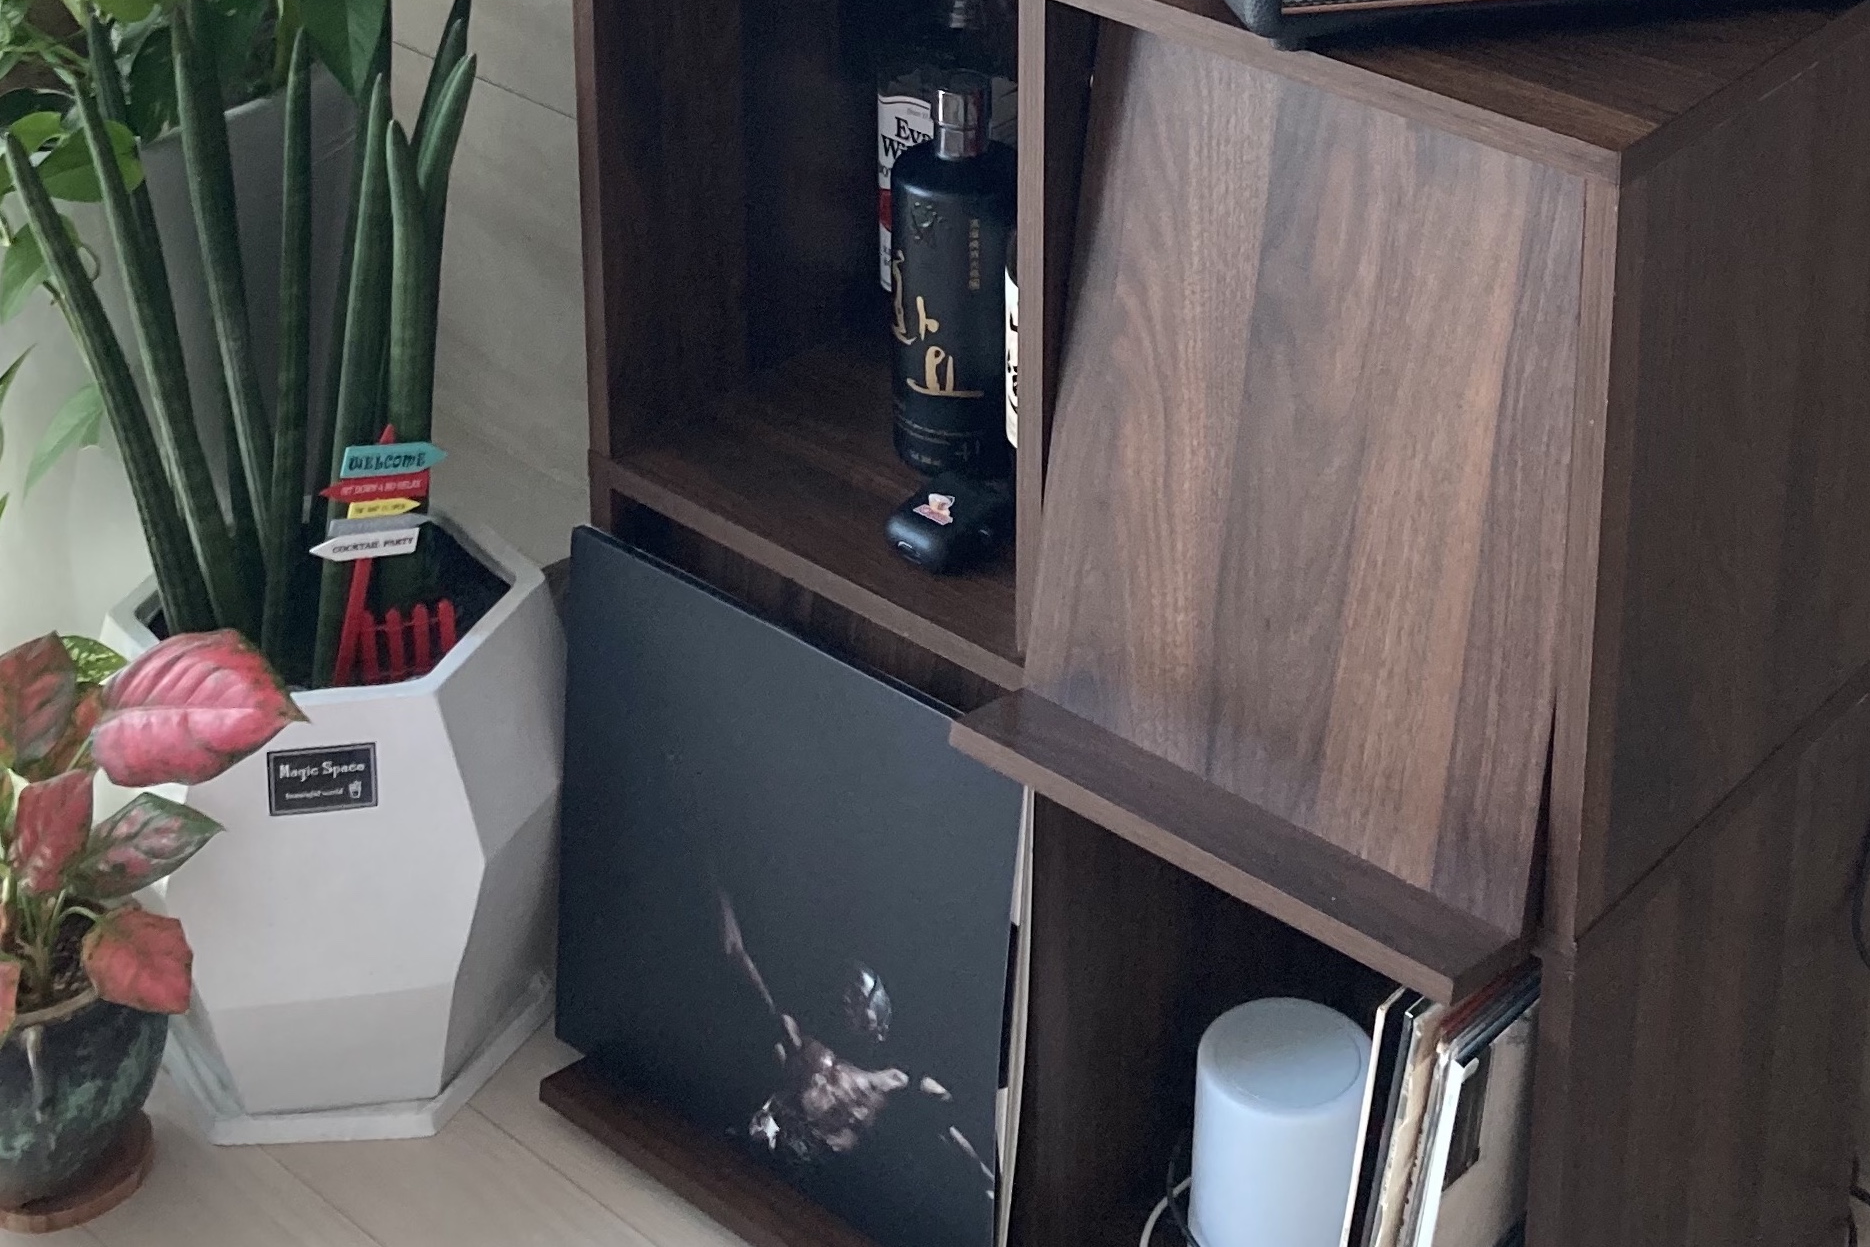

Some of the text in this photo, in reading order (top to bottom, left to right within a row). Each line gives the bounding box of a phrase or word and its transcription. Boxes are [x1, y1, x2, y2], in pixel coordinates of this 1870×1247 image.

[348, 452, 427, 471] WELCOME
[383, 537, 414, 548] PARTY
[279, 760, 366, 782] Magic Space
